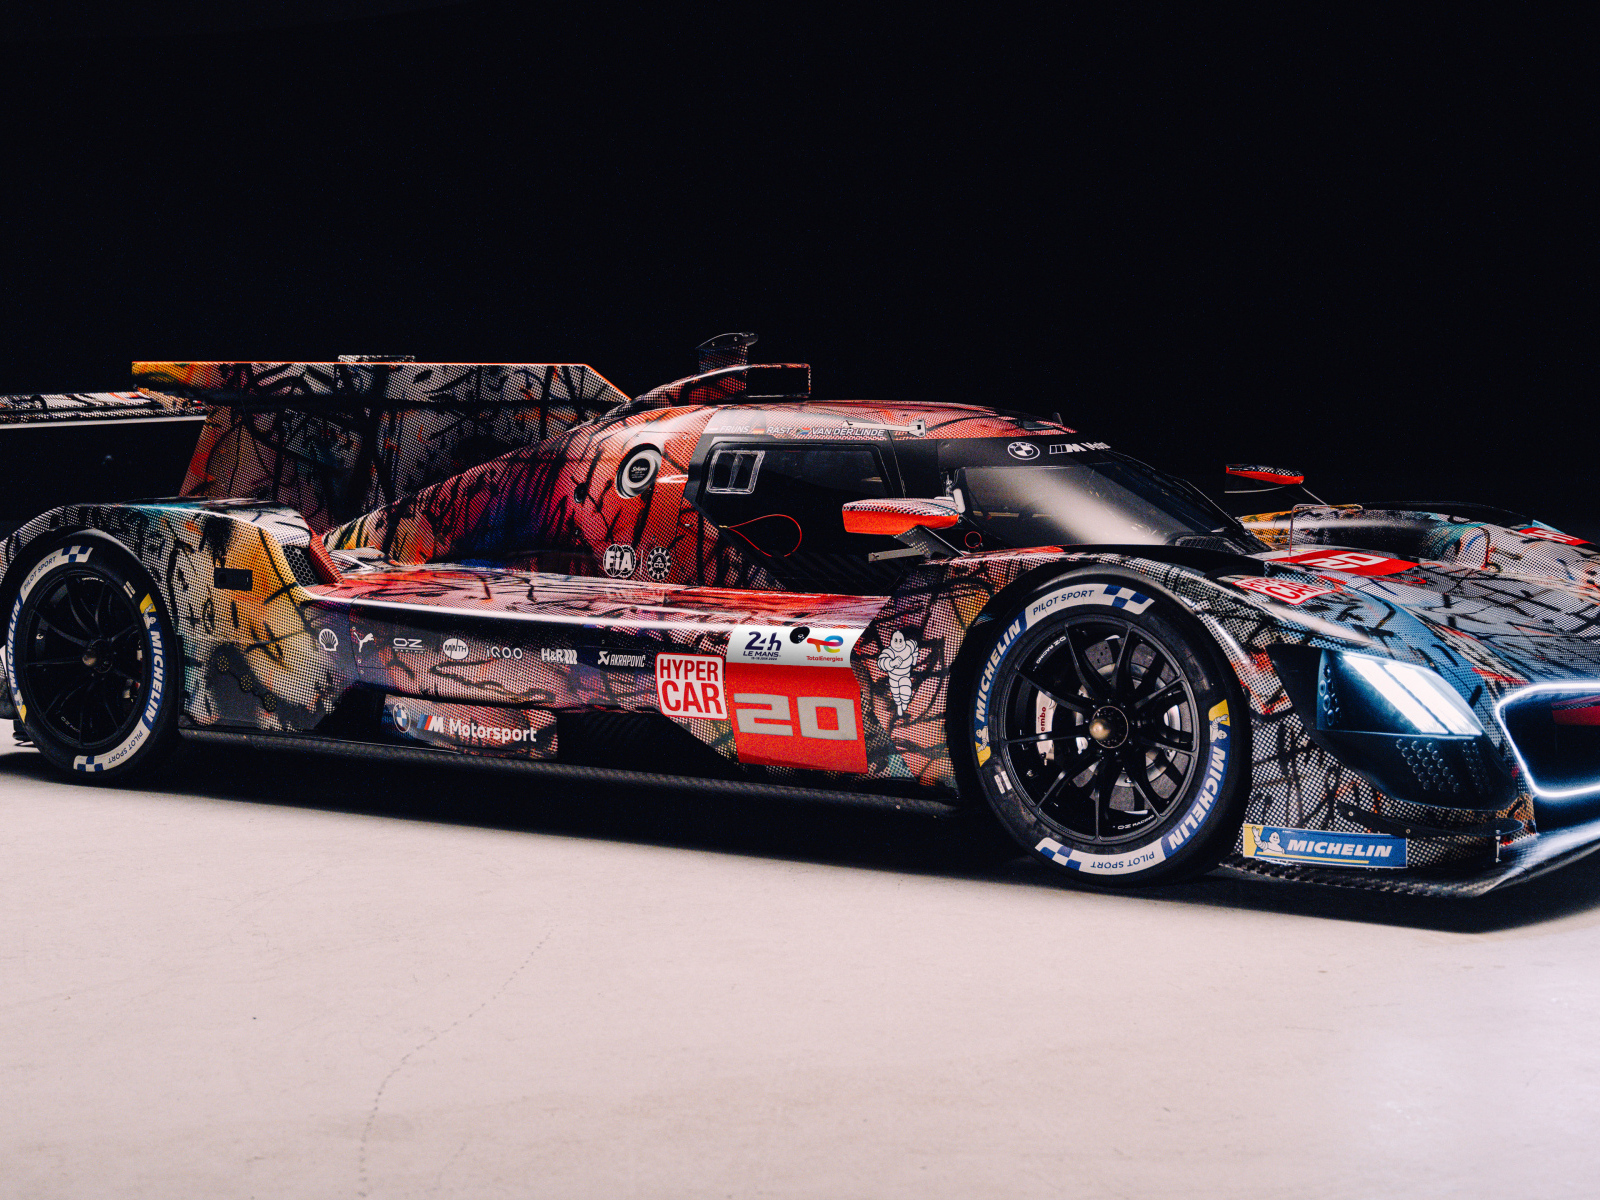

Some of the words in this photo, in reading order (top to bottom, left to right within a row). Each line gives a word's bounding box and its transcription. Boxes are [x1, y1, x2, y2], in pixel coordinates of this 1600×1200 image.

[766, 426, 793, 434] RAST
[811, 427, 832, 435] VAN
[833, 428, 853, 436] DER
[855, 428, 885, 437] LINDE
[23, 569, 38, 591] PILOT
[37, 556, 57, 572] SPORT
[1032, 597, 1061, 616] PILOT
[1061, 589, 1095, 602] SPORT
[7, 598, 21, 687] MICHELIN
[744, 631, 782, 651] 24h
[541, 648, 564, 663] H&R
[806, 655, 844, 663] TotalEnergies
[145, 632, 164, 723] MICHELIN
[659, 658, 719, 682] HYPER
[975, 619, 1021, 722] MICHELIN
[661, 680, 723, 715] CAR
[733, 693, 858, 741] 20
[128, 730, 144, 752] PILOT
[450, 718, 538, 744] Motorsport
[108, 748, 129, 764] SPORT
[1168, 748, 1226, 850] MICHELIN
[1130, 851, 1156, 866] PILOT
[1286, 839, 1393, 858] MICHELIN
[1090, 859, 1129, 870] SPORT
